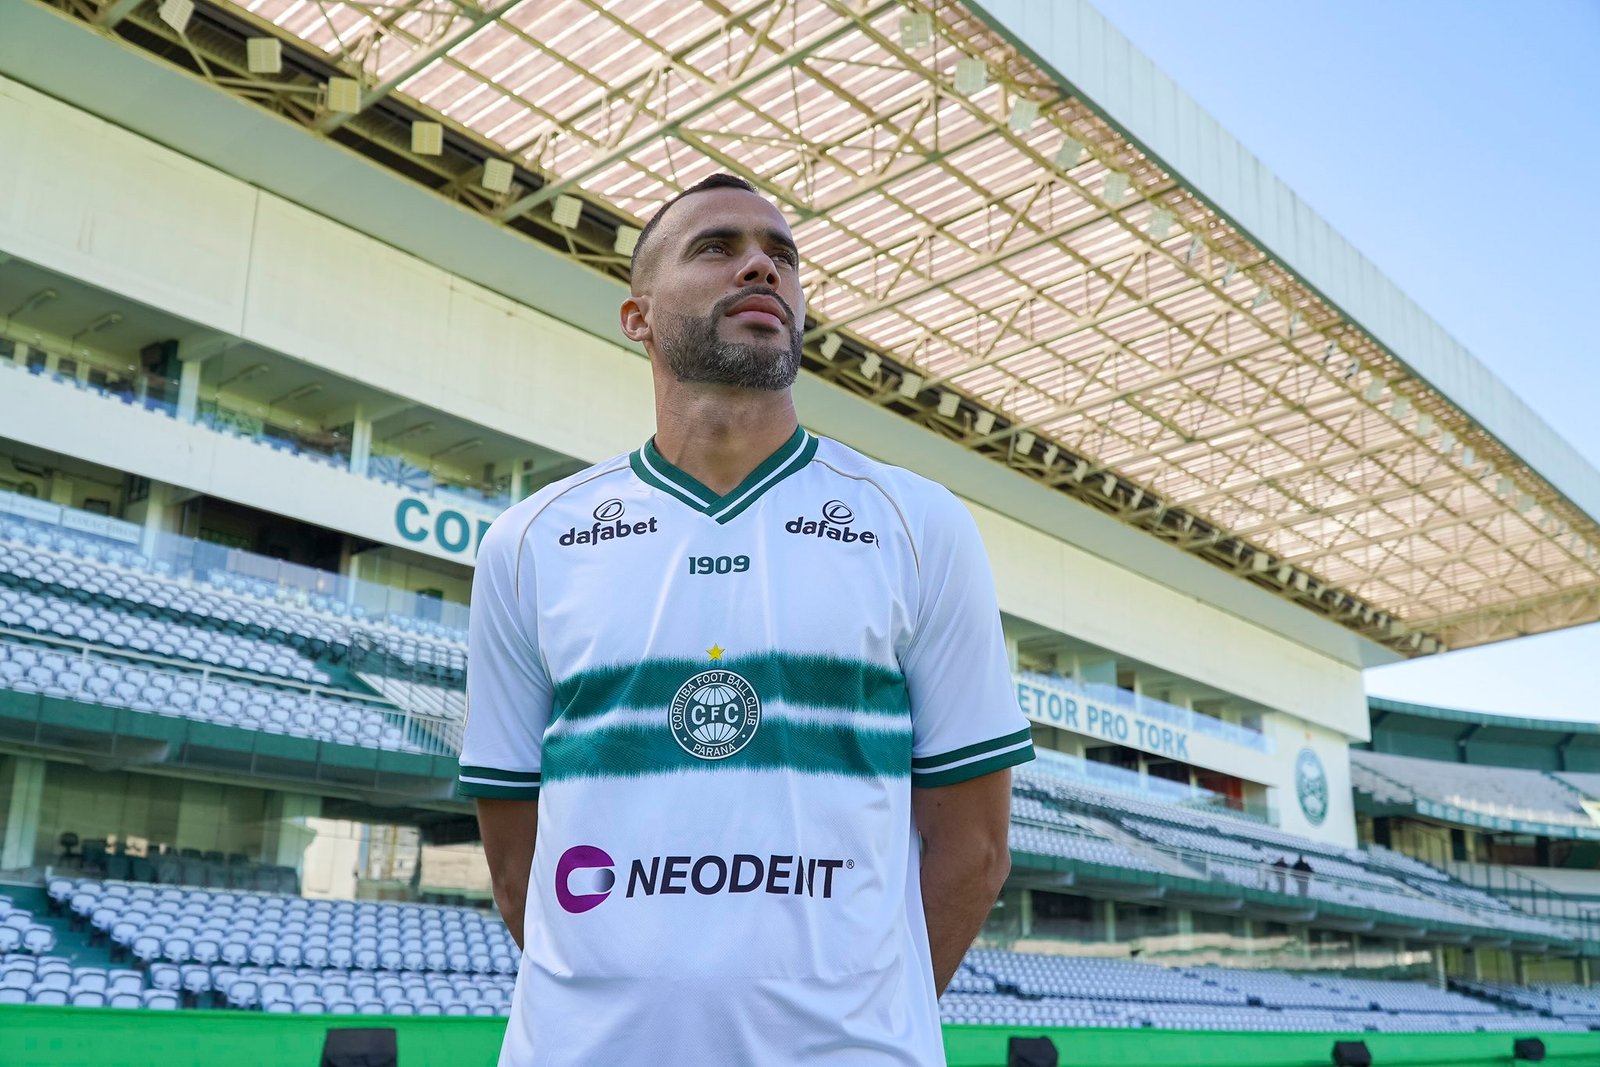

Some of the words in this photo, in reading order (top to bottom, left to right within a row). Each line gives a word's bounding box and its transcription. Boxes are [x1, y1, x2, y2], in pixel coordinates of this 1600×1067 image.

[558, 516, 658, 546] dafabet
[688, 554, 750, 575] 1909
[672, 683, 697, 730] CORITIBA
[696, 672, 725, 687] FOOT
[726, 674, 750, 697] BALL
[746, 696, 757, 726] CLUB
[1086, 704, 1129, 741] PRO
[1134, 719, 1189, 760] TORK
